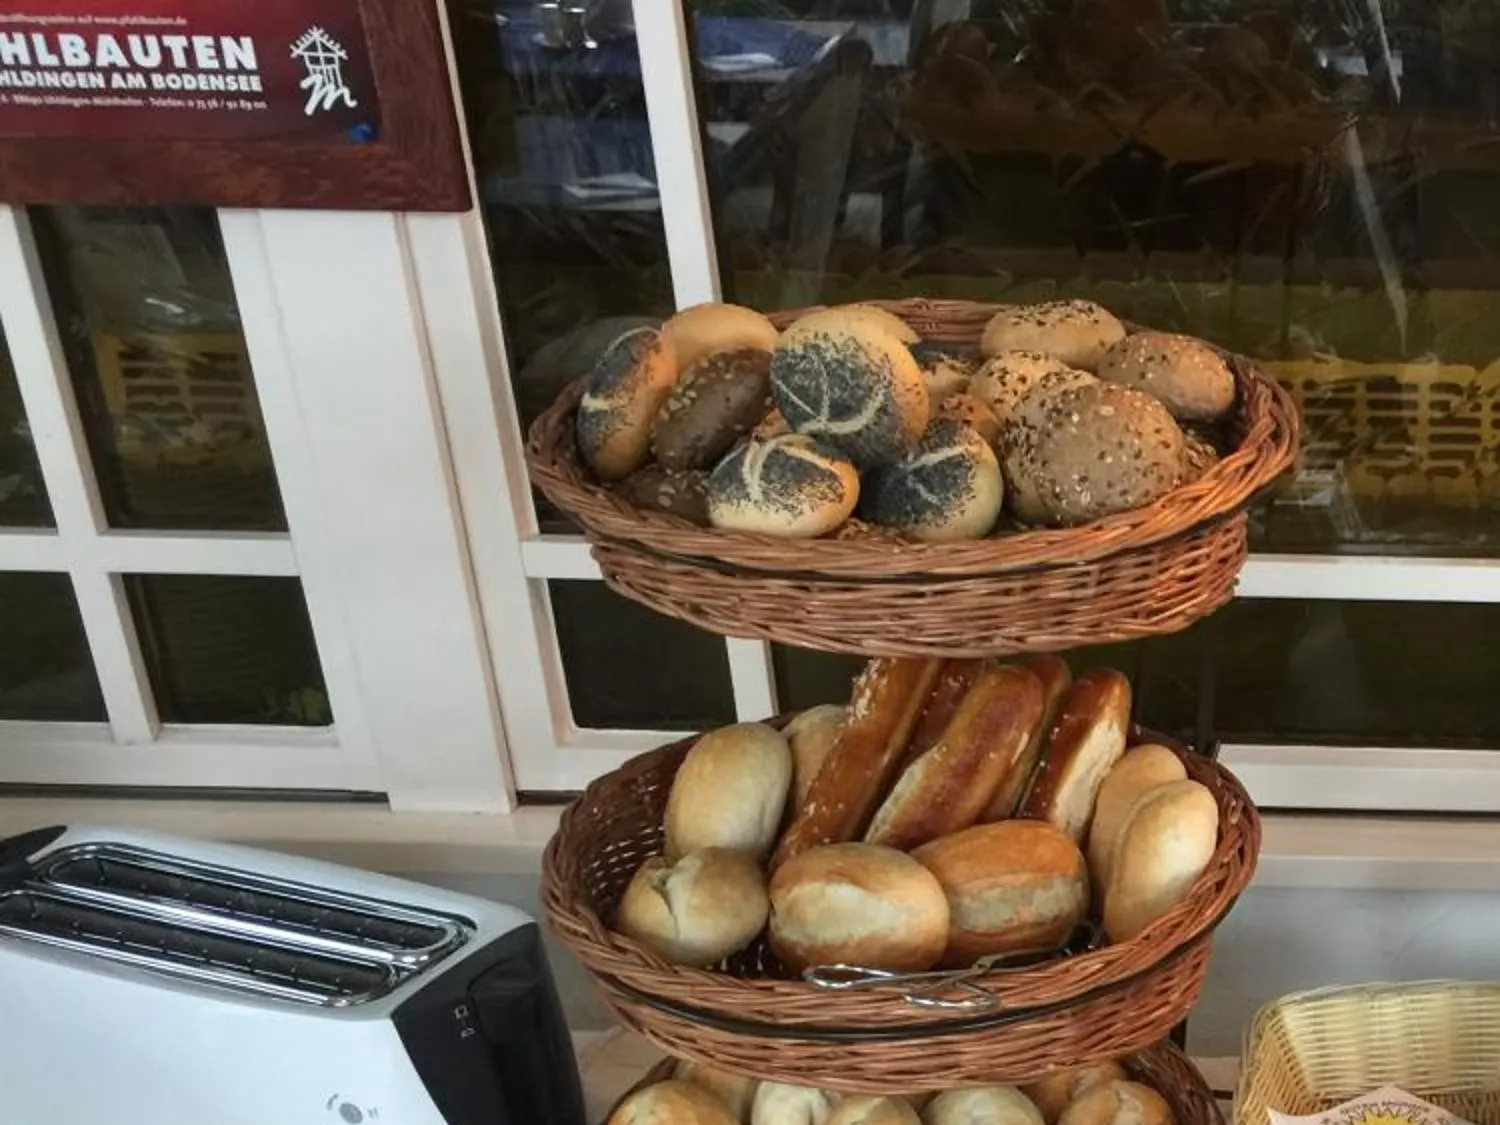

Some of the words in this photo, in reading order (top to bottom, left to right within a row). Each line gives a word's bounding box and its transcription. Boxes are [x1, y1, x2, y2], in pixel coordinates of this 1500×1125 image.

[0, 31, 257, 70] HLBAUTEN
[111, 72, 147, 89] AM
[151, 73, 263, 92] BODENSEE
